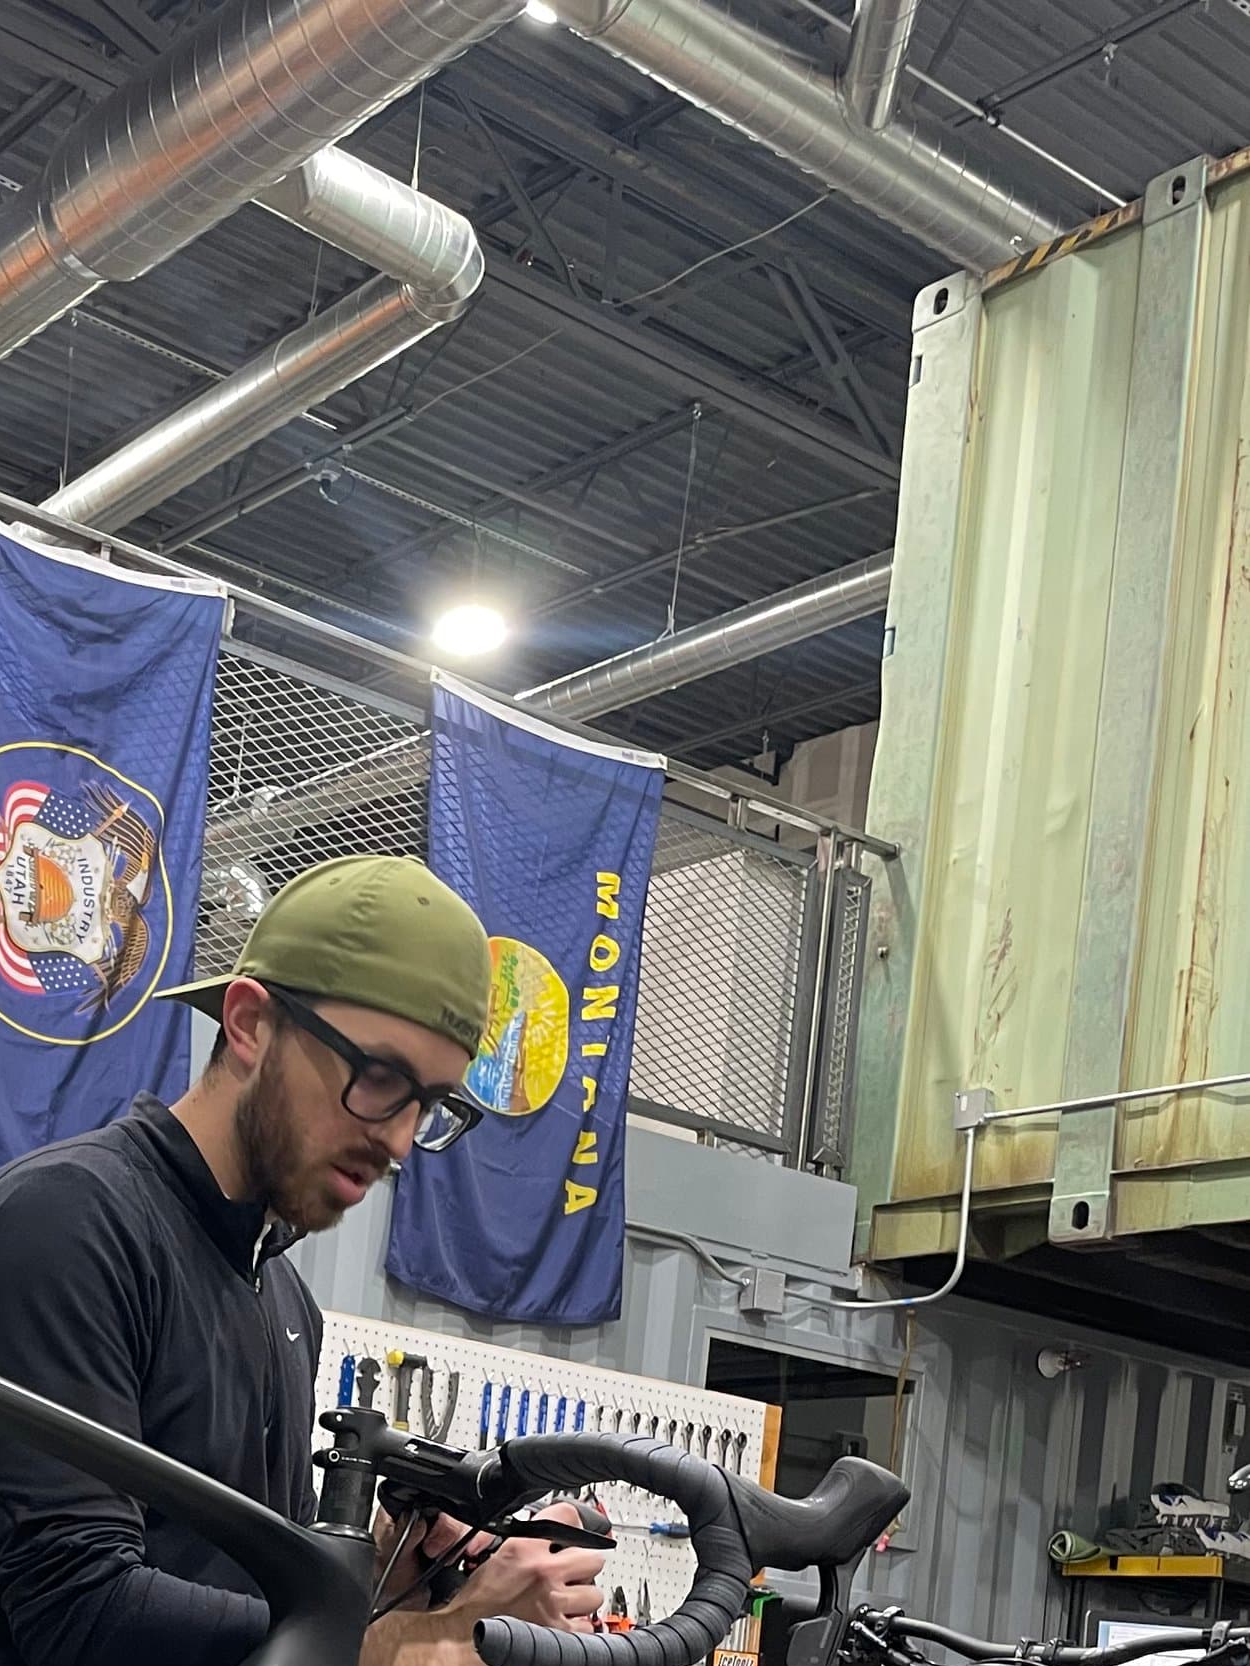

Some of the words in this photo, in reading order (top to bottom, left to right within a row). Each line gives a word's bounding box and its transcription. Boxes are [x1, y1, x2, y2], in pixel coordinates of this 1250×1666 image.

[5, 864, 15, 894] 1847
[12, 856, 27, 905] UTAH
[76, 858, 96, 945] INDUSTRY
